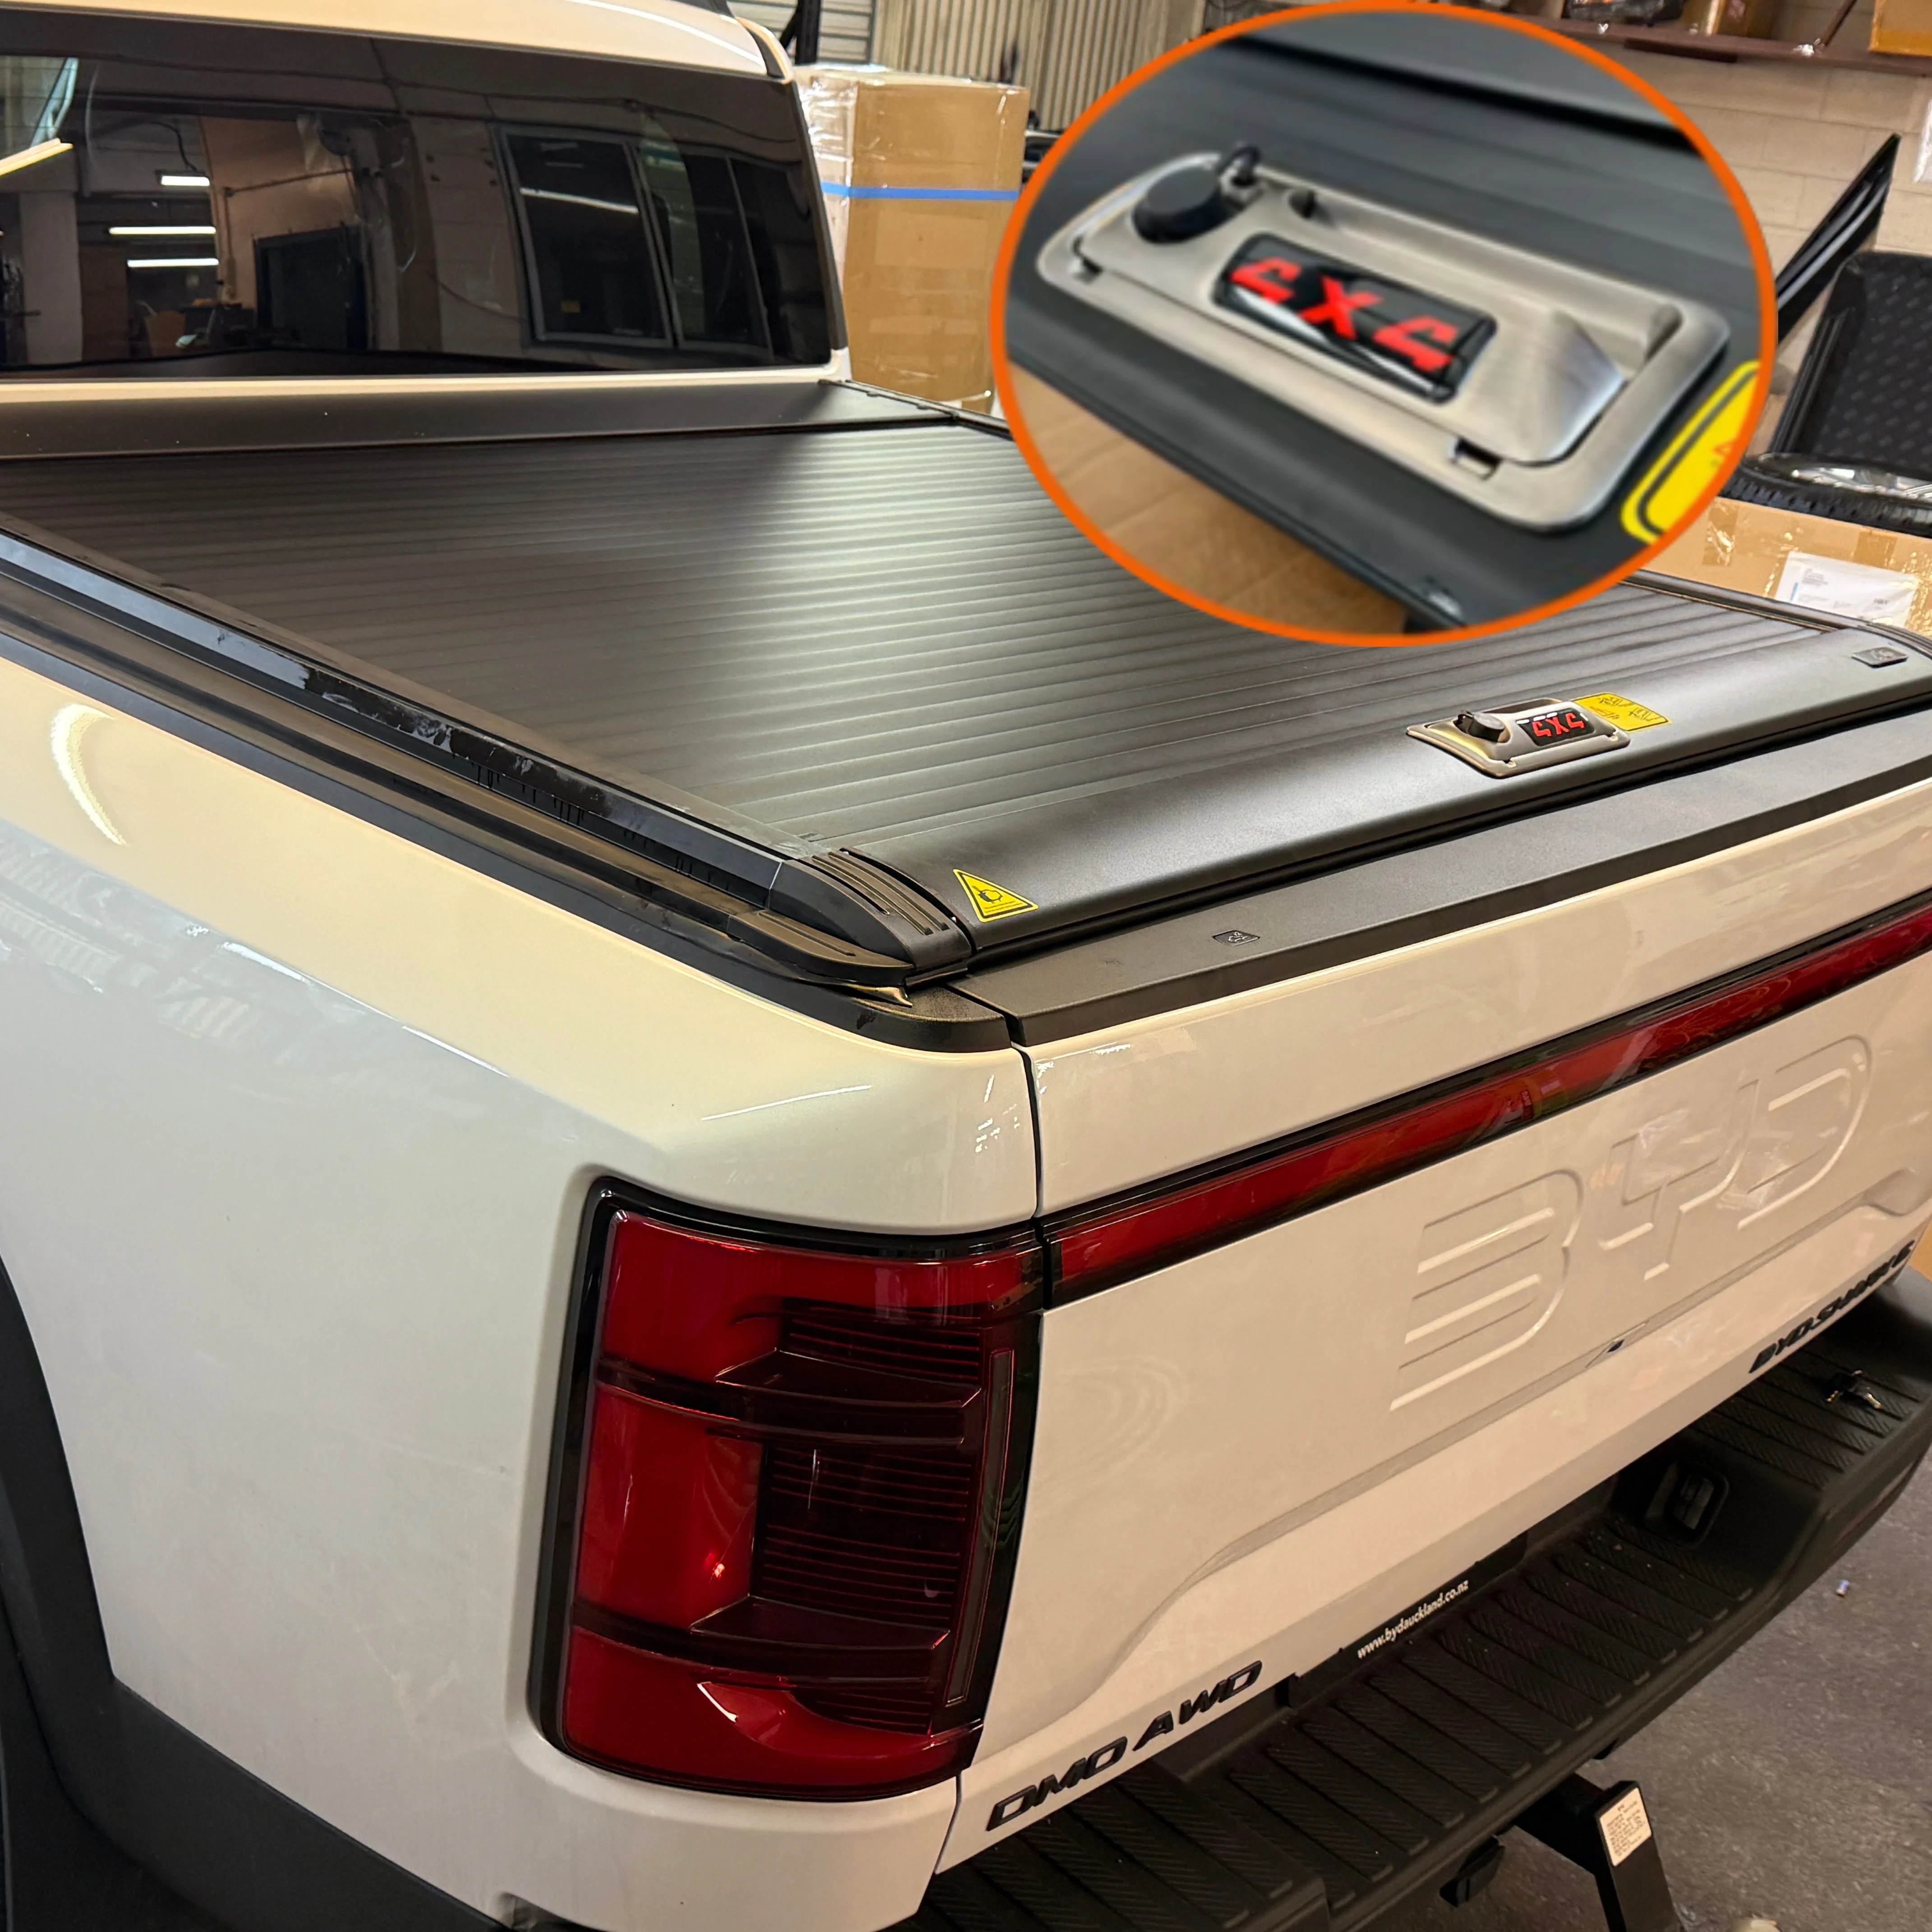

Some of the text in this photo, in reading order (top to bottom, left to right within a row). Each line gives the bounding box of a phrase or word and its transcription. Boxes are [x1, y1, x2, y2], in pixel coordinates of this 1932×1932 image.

[1389, 1034, 1873, 1412] BYD
[1357, 1580, 1469, 1659] www.bydauckland.co.nz
[985, 1660, 1263, 1832] DMO AWD
